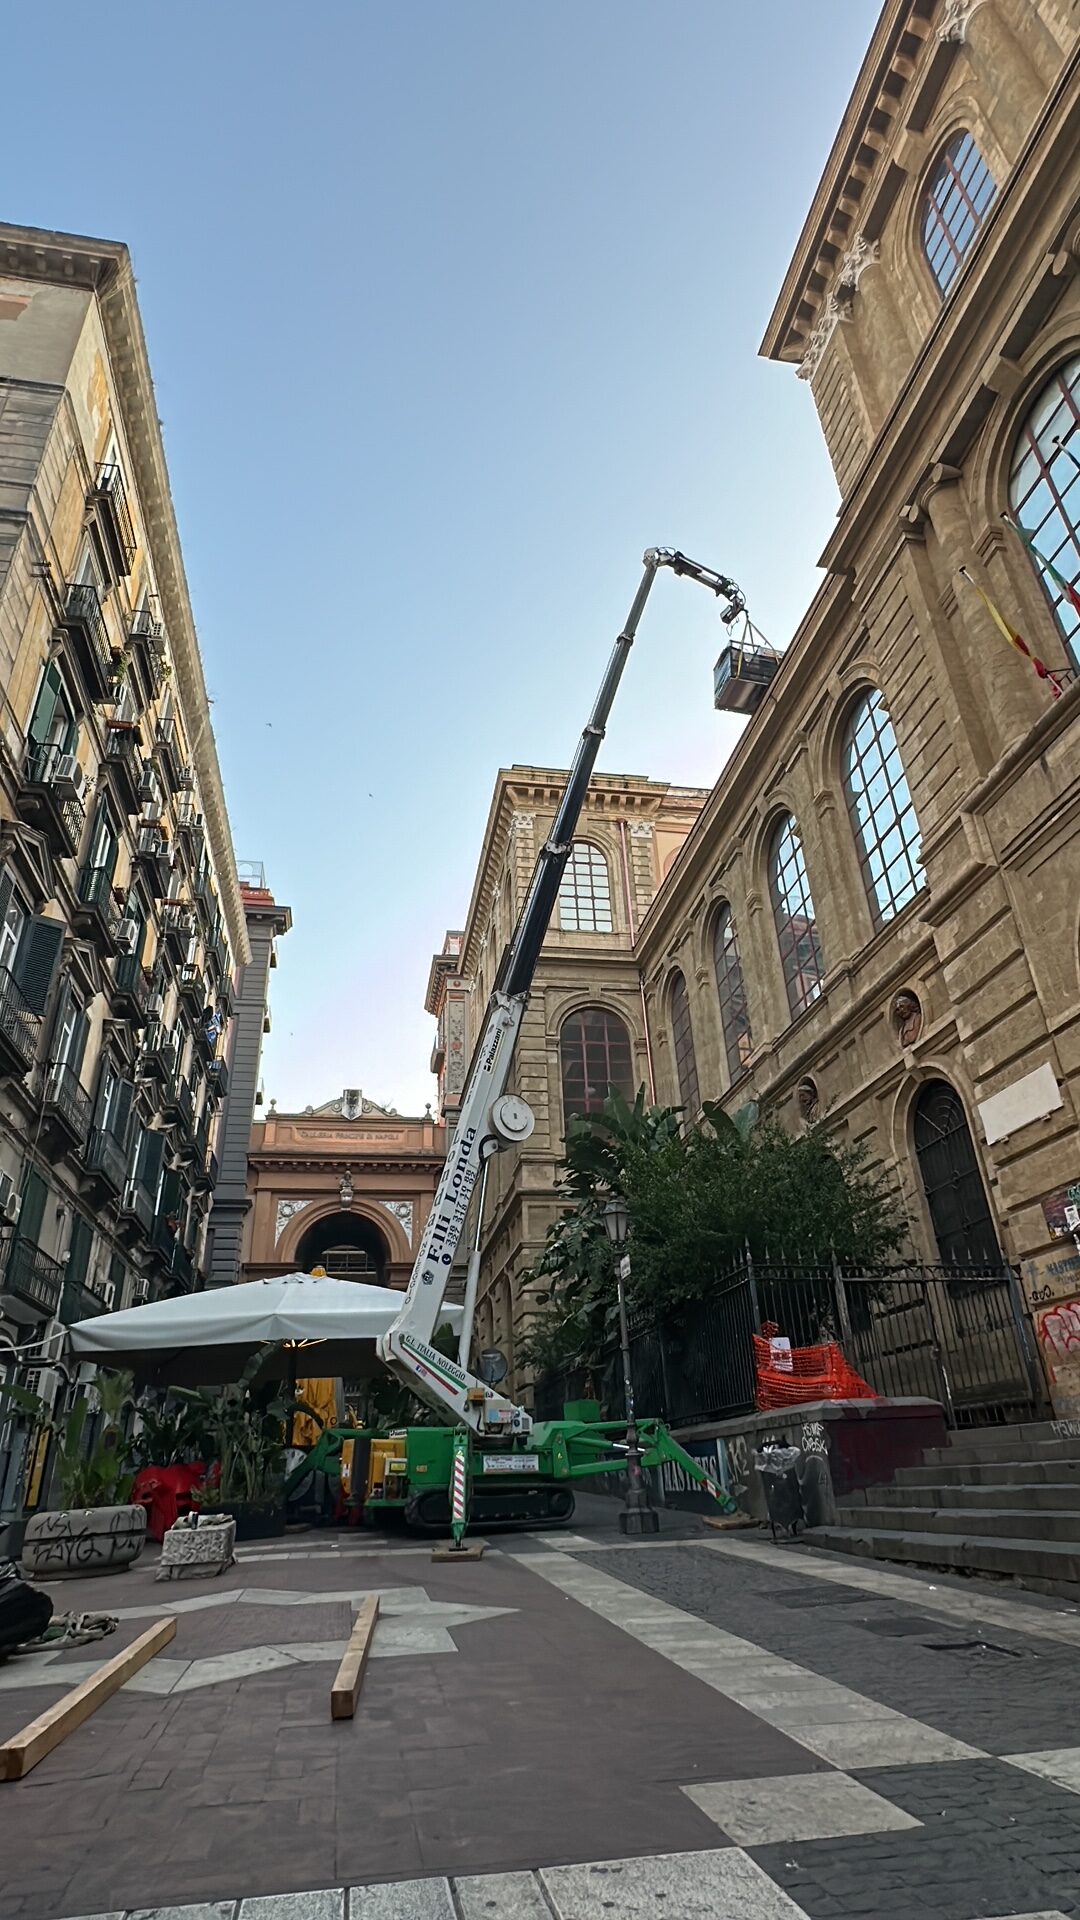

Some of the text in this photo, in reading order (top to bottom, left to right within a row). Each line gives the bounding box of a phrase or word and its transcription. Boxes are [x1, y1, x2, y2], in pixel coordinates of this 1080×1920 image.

[486, 1028, 503, 1066] Palazzani
[375, 1133, 399, 1141] NAPOLI
[427, 1214, 451, 1264] F.lli
[444, 1127, 477, 1205] Londa
[416, 1343, 436, 1361] ITALIA
[437, 1358, 466, 1381] NOLEGGIO
